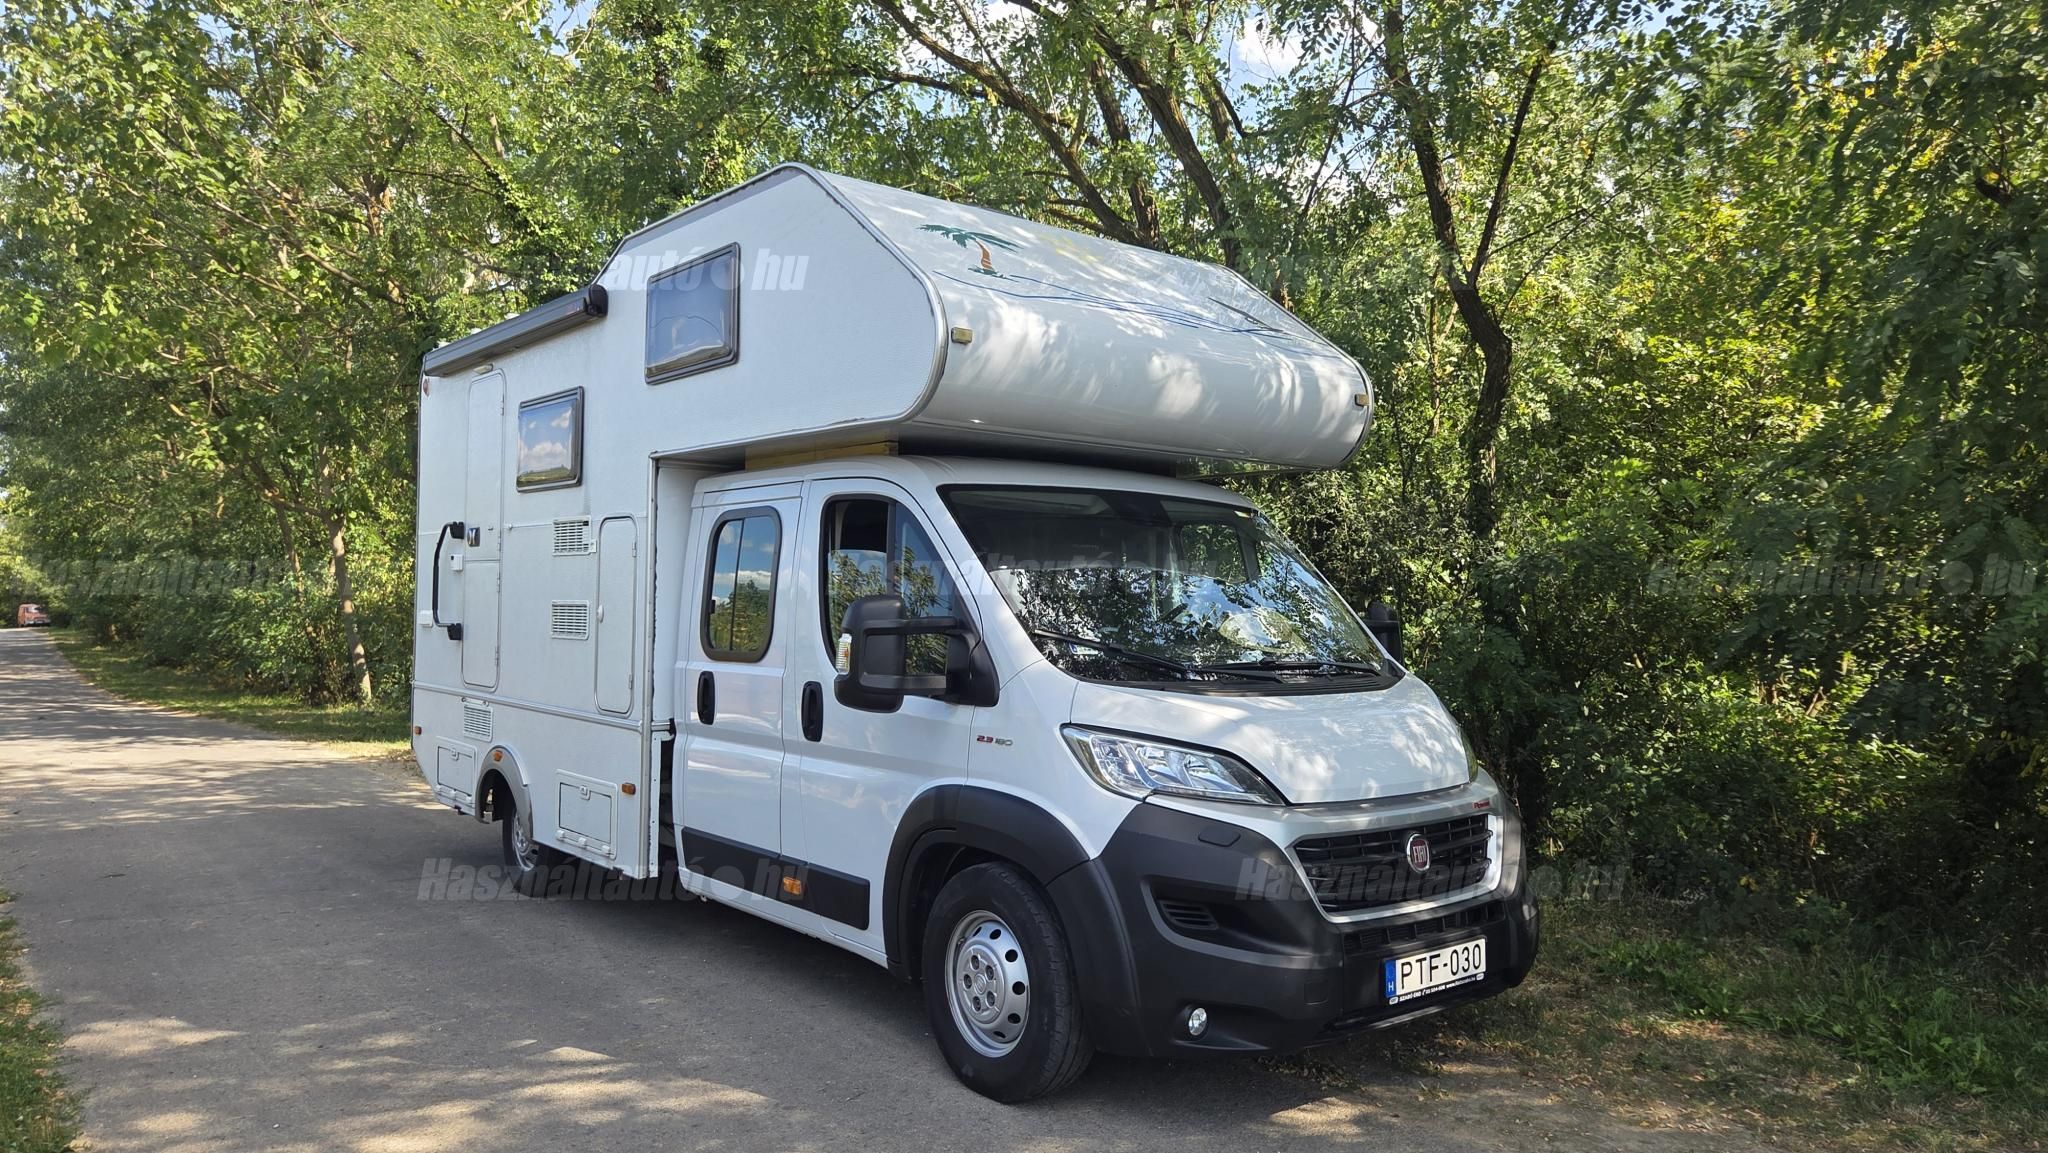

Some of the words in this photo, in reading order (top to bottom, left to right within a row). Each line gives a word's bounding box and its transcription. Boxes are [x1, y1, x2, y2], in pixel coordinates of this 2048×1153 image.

[1412, 845, 1427, 863] FIAT
[1401, 943, 1482, 990] PTF-030
[1387, 981, 1394, 992] H
